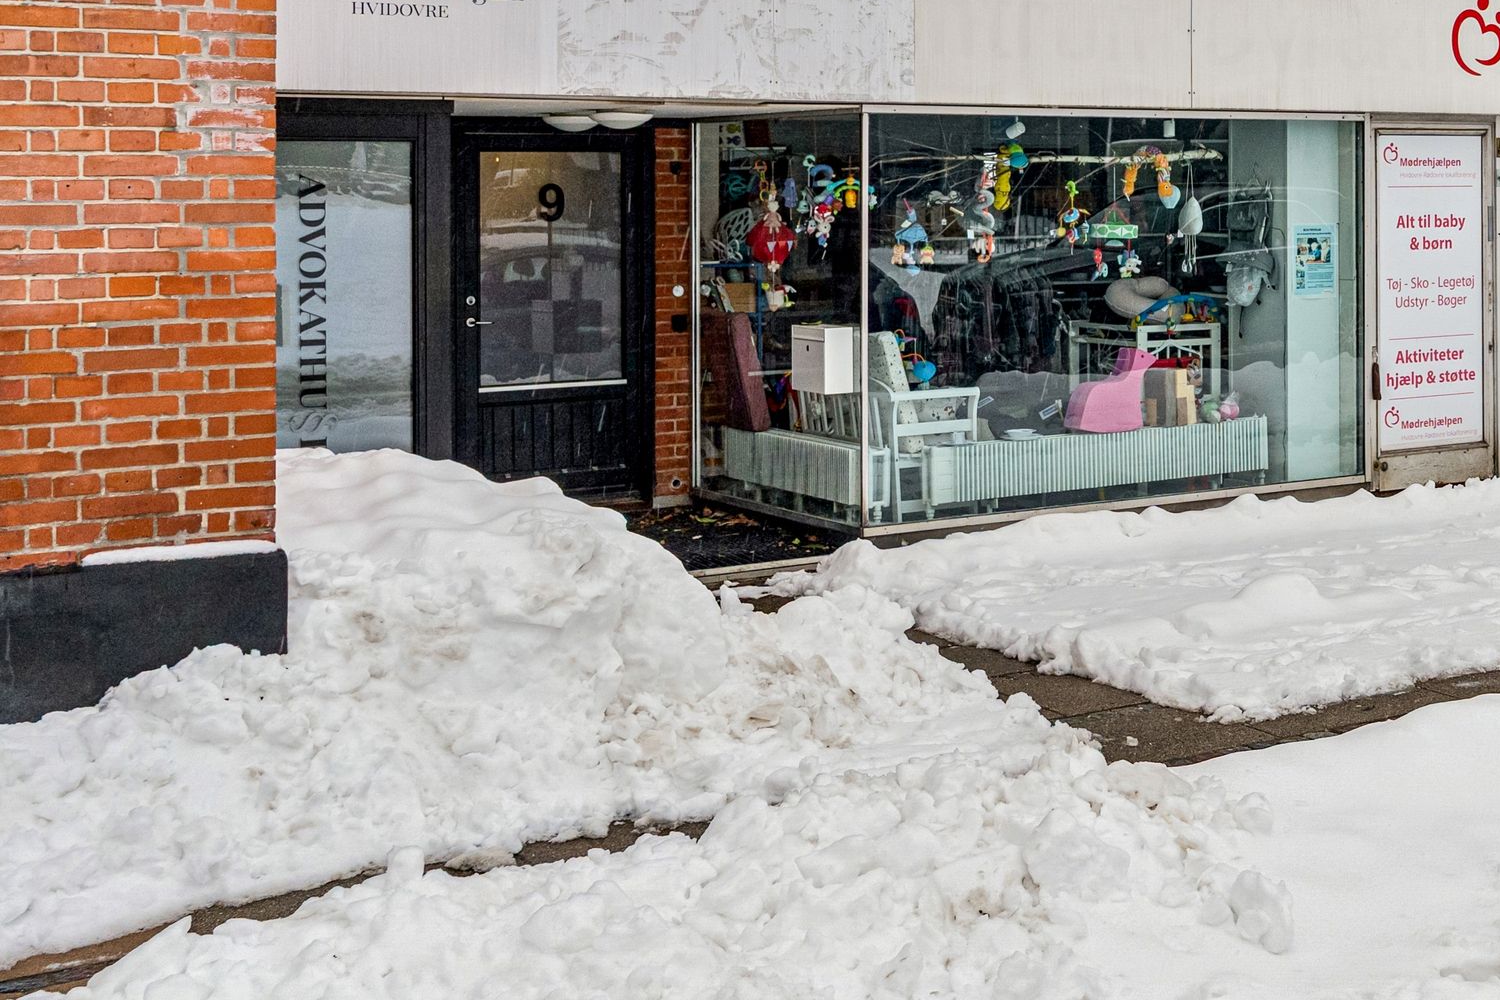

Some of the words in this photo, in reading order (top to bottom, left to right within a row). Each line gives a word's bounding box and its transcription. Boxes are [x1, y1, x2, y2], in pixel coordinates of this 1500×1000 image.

[351, 1, 449, 19] HVIDOVRE
[1399, 157, 1462, 169] Mødrehjælpen
[538, 183, 565, 222] 9
[1396, 214, 1415, 229] Alt
[1418, 214, 1431, 228] til
[1434, 213, 1466, 231] baby
[1409, 236, 1420, 251] &
[1422, 236, 1453, 250] børn
[1386, 278, 1402, 292] Tøj
[1410, 276, 1430, 290] Sko
[1437, 275, 1475, 291] Legetøj
[1395, 296, 1429, 310] Udstyr
[1437, 294, 1467, 309] Bøger
[1395, 348, 1464, 365] Aktiviteter
[1386, 371, 1424, 390] hjælp
[1426, 370, 1436, 384] &
[1439, 368, 1476, 383] støtte
[1401, 416, 1463, 430] Mødrehjælpen
